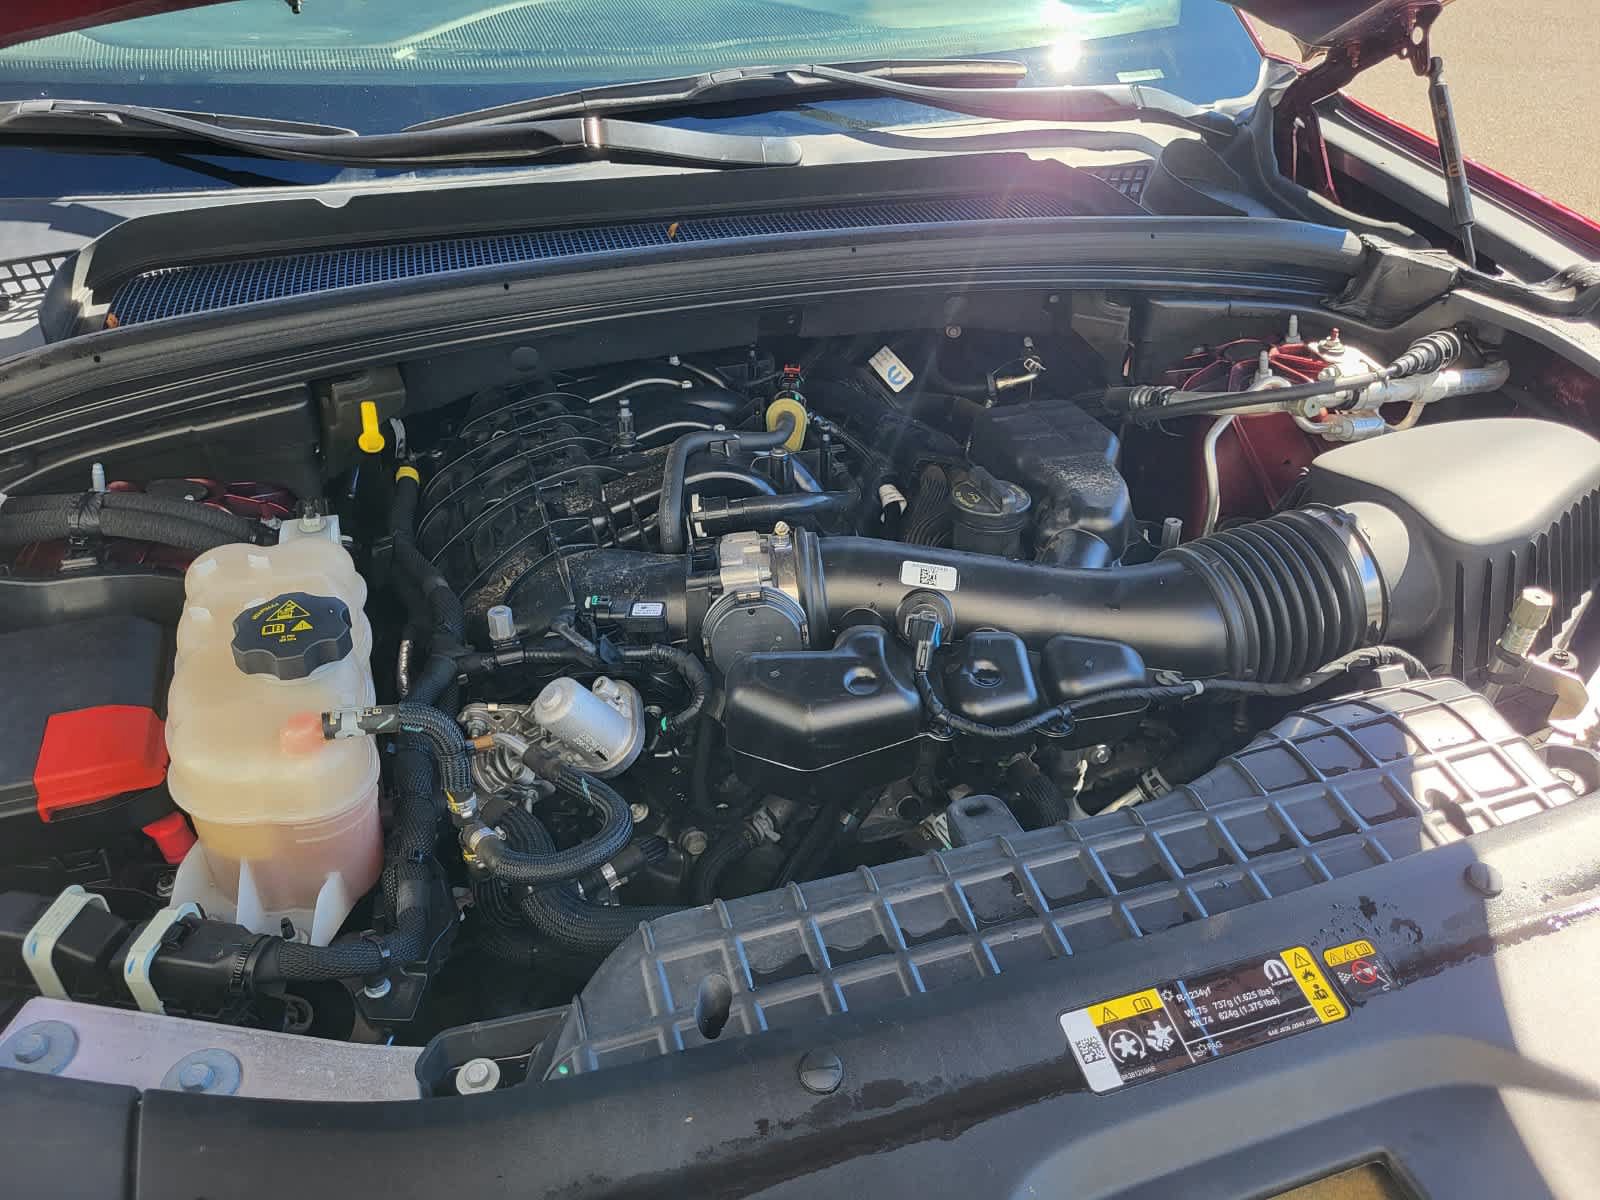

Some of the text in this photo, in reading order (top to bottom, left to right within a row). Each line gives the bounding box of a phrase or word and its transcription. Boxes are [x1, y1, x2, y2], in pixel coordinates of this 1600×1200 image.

[1212, 998, 1234, 1010] 737g
[1233, 993, 1258, 1006] (1.625
[1257, 986, 1275, 998] lbs)
[1218, 1009, 1240, 1021] 624g
[1239, 1003, 1264, 1016] (1.375
[1262, 996, 1281, 1008] lbs)
